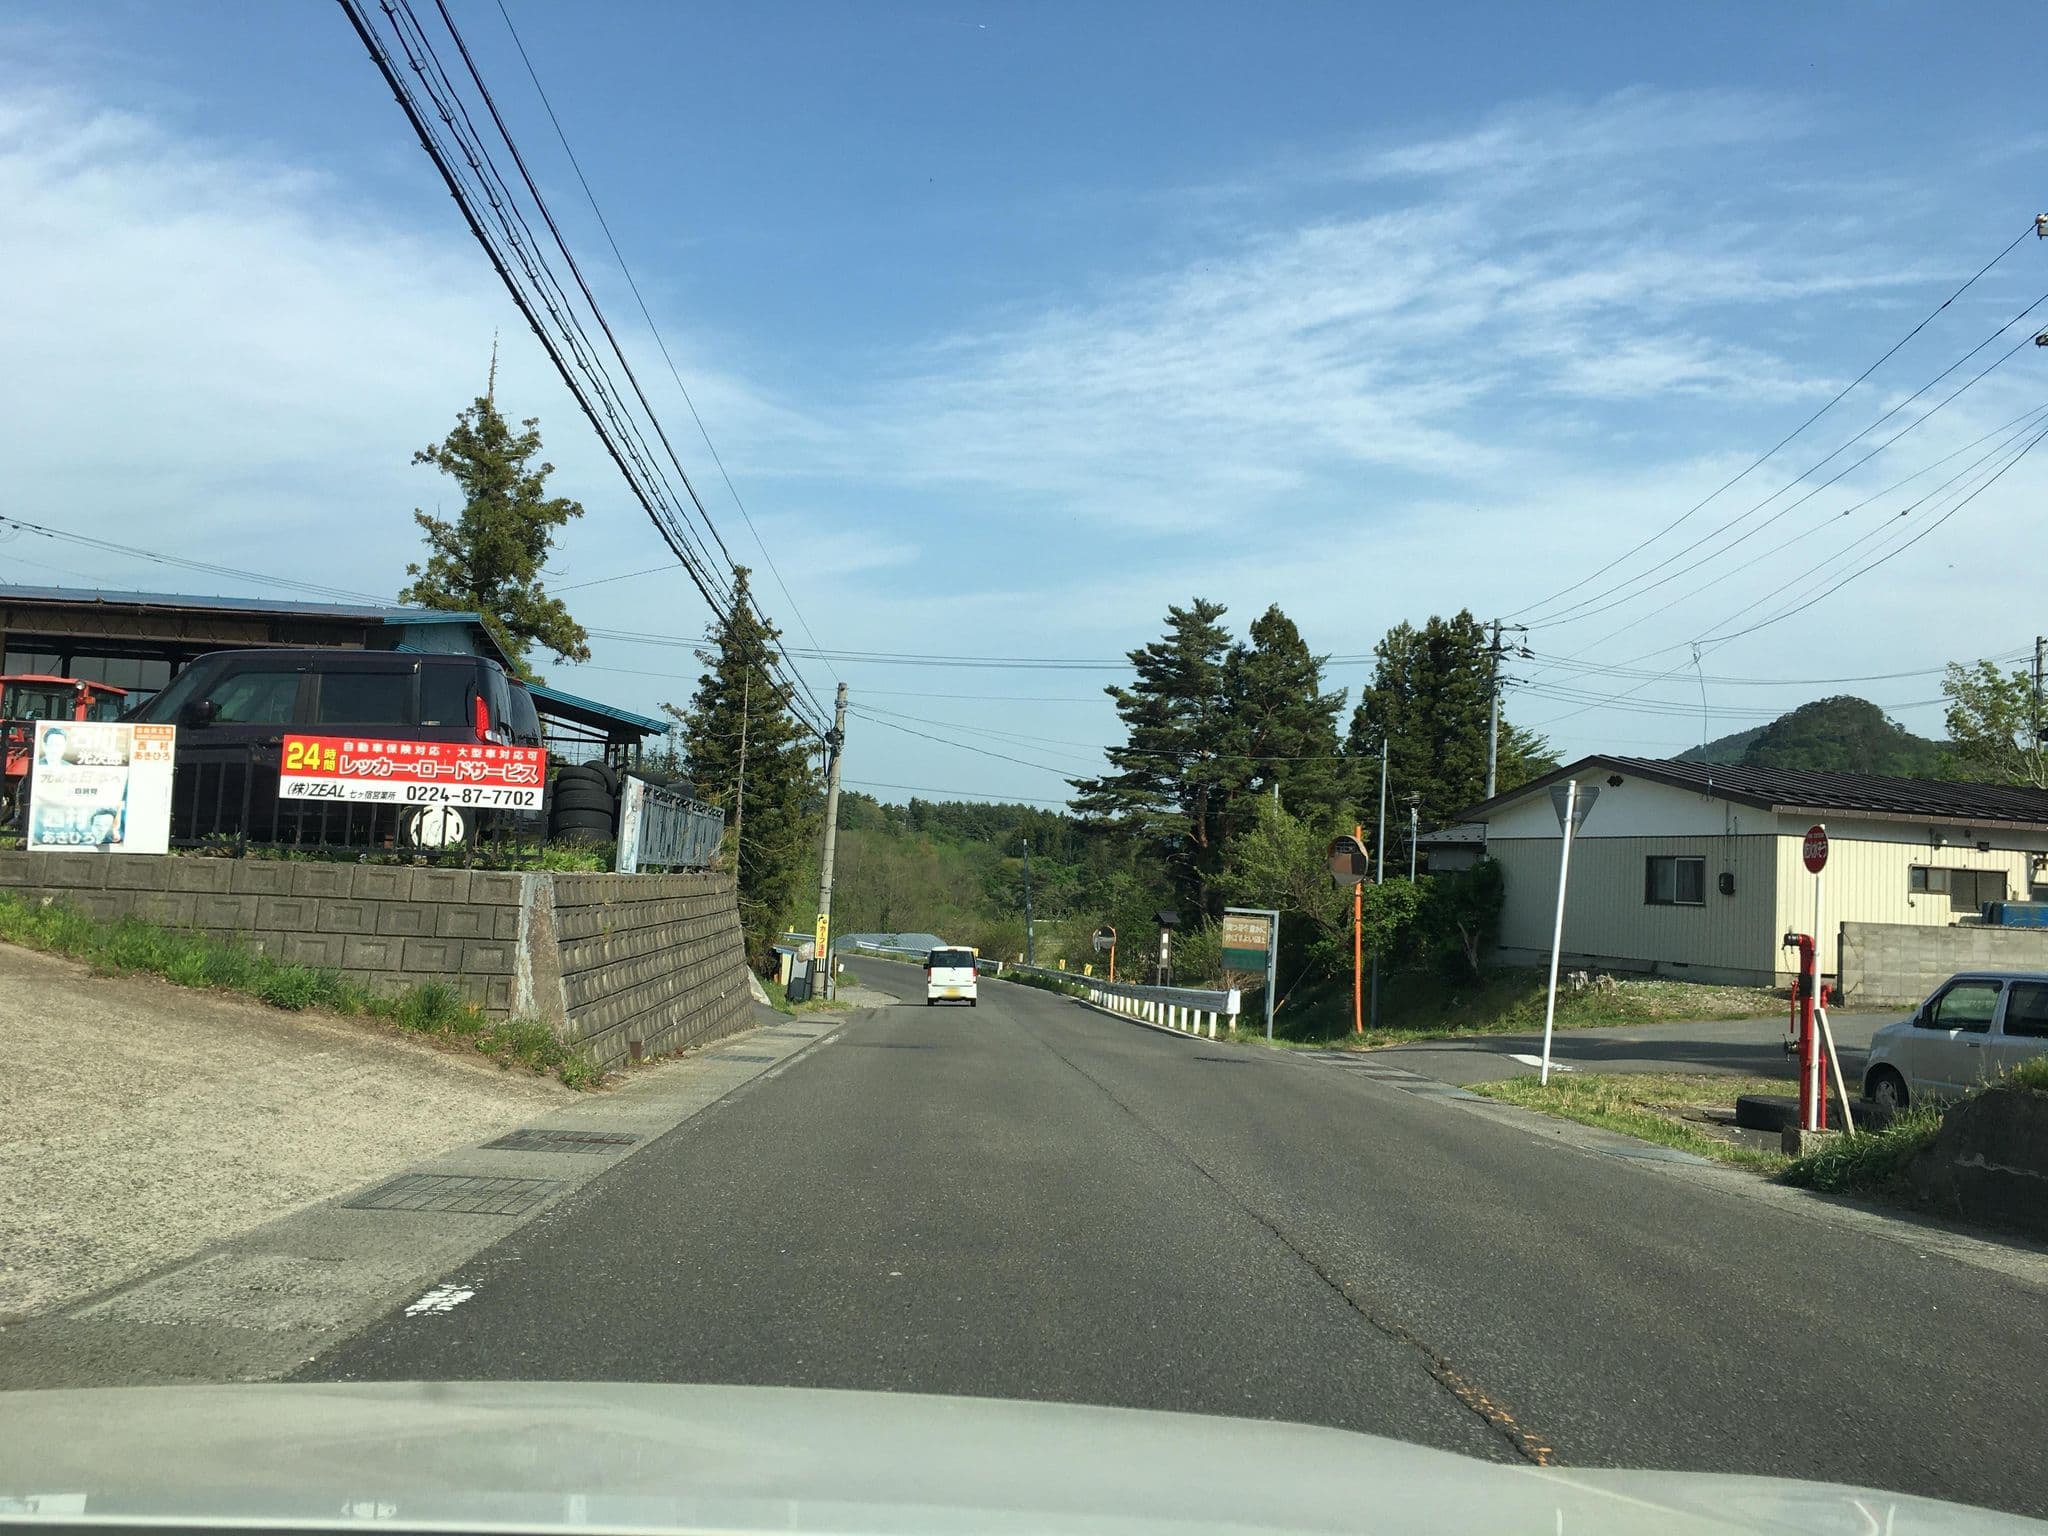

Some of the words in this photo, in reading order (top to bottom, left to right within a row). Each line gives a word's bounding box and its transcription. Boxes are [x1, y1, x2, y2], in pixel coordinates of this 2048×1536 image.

[134, 752, 171, 761] あきひろ
[286, 741, 321, 770] 24
[323, 748, 337, 771] 時間
[339, 755, 539, 784] レッカー・ロードサービス
[406, 786, 535, 806] 0224-87-7702
[42, 831, 96, 845] あきひろ
[818, 926, 826, 957] カーブ注意
